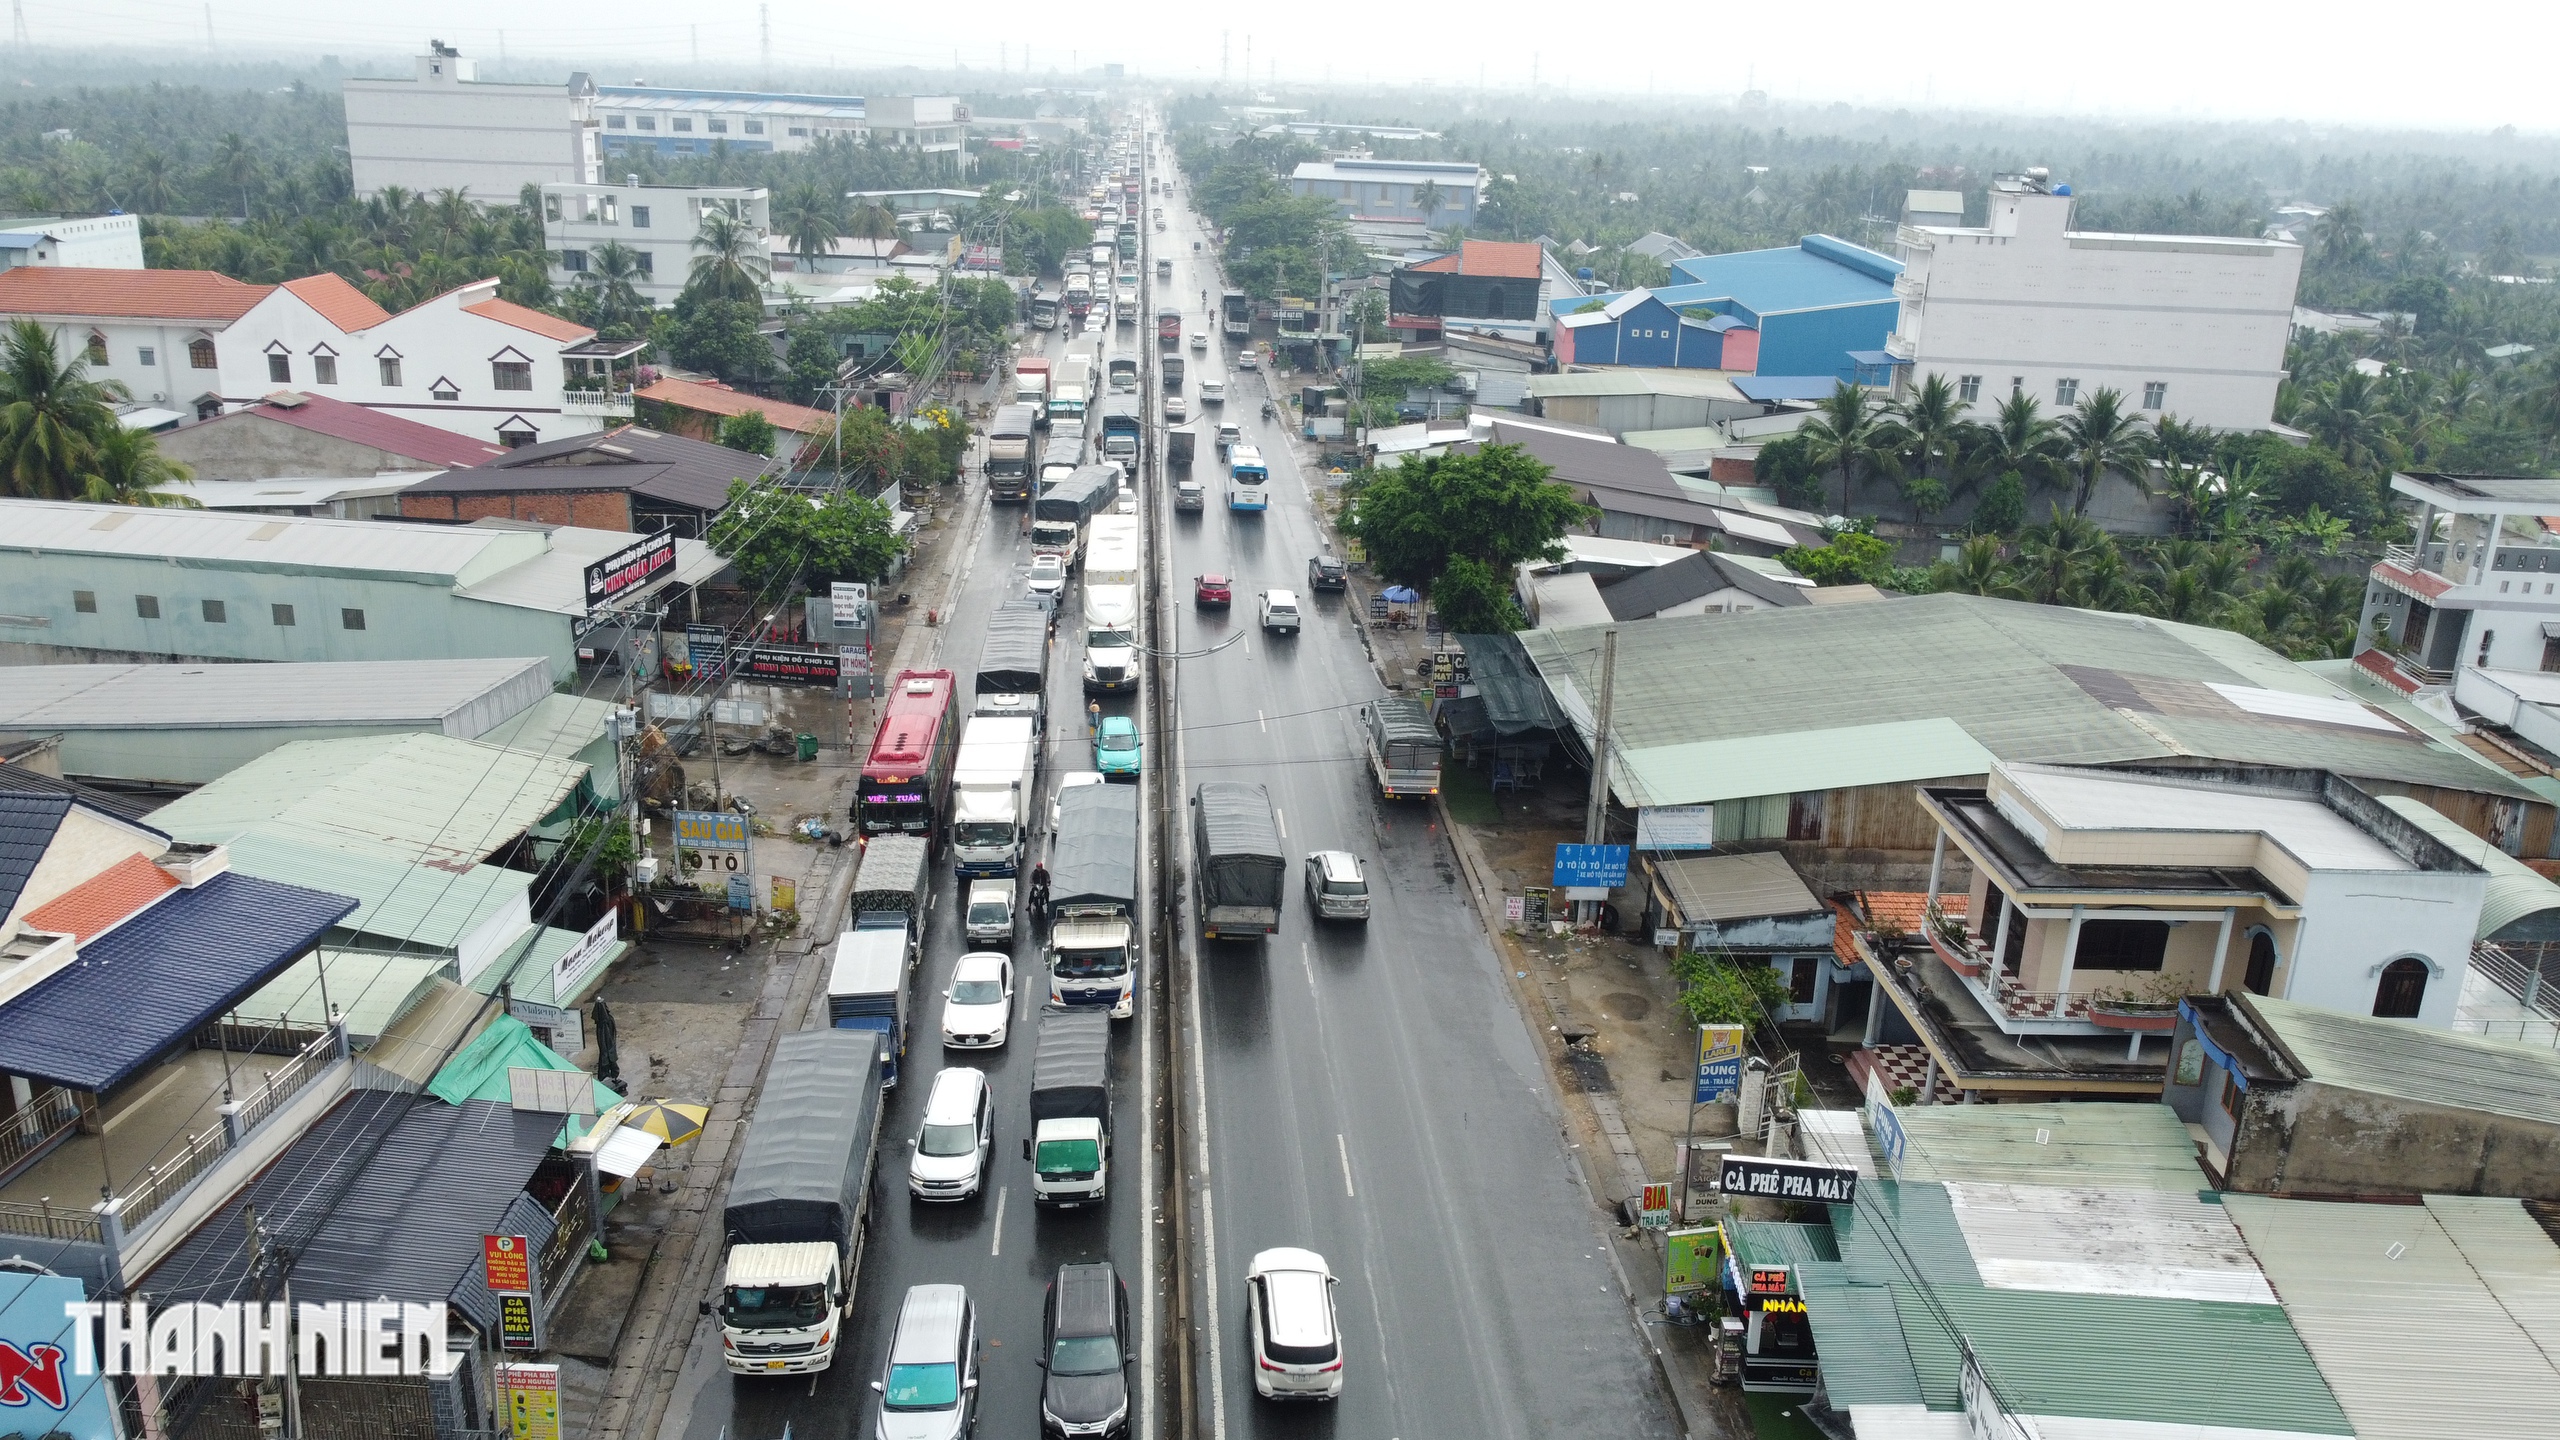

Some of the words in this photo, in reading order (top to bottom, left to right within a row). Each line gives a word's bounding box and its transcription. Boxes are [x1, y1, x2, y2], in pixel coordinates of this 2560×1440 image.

[662, 533, 671, 544] XE
[605, 569, 625, 595] MINH
[650, 547, 672, 571] AUTO
[841, 646, 866, 655] GARAGE
[810, 667, 837, 677] AUTO
[867, 794, 888, 802] VIỆT
[679, 819, 712, 839] SAU
[715, 822, 744, 840] GIA
[1558, 860, 1564, 869] Ô
[1567, 860, 1577, 869] TÔ
[1581, 860, 1587, 869] Ô
[1590, 861, 1600, 869] TÔ
[522, 1005, 557, 1018] Makeup
[1705, 1047, 1733, 1059] LARUE
[1701, 1065, 1736, 1075] DUNG
[1713, 1076, 1723, 1084] TRÀ
[1725, 1166, 1746, 1191] CÀ
[1749, 1169, 1780, 1194] PHÊ
[1782, 1175, 1813, 1197] PHA
[1816, 1174, 1852, 1200] MÁY
[1643, 1185, 1670, 1211] BIA
[1642, 1213, 1654, 1226] TRÀ
[502, 1240, 510, 1249] P
[489, 1251, 502, 1259] VUI
[504, 1250, 524, 1259] LÒNG
[1754, 1271, 1766, 1282] CÀ
[508, 1298, 523, 1306] CÀ
[505, 1306, 527, 1315] PHÊ
